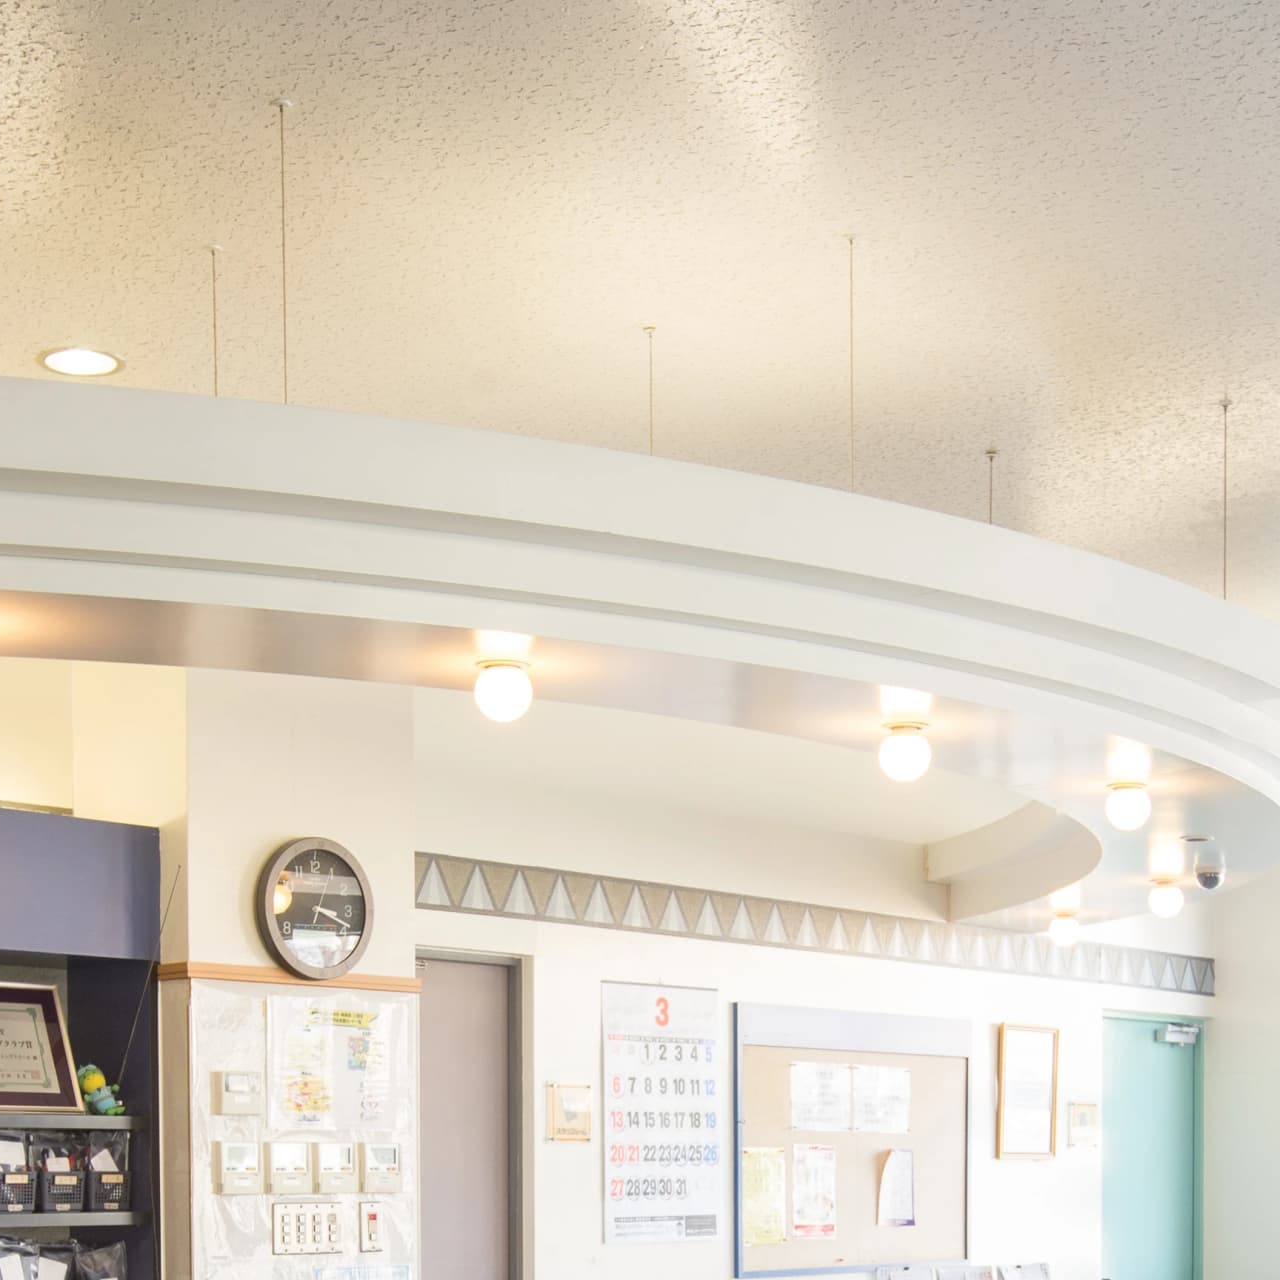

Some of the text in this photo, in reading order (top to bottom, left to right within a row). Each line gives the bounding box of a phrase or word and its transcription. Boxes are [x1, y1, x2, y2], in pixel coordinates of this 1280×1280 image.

[295, 866, 302, 878] 11
[310, 861, 320, 873] 12
[341, 884, 348, 896] 2
[345, 905, 352, 917] 3
[283, 921, 291, 934] 8
[655, 997, 669, 1026] 3
[644, 1044, 650, 1061] 1
[659, 1045, 667, 1061] 2
[674, 1045, 683, 1061] 3
[690, 1045, 698, 1062] 4
[613, 1077, 621, 1093] 6
[628, 1077, 636, 1094] 7
[644, 1078, 652, 1094] 8
[660, 1078, 667, 1094] 9
[673, 1078, 685, 1095] 10
[690, 1079, 700, 1095] 11
[611, 1111, 716, 1129] 13 14 15 16 17 18 19
[610, 1145, 717, 1163] 20 21 22 23 24 25 26
[611, 1180, 687, 1197] 27 28 29 30 31
